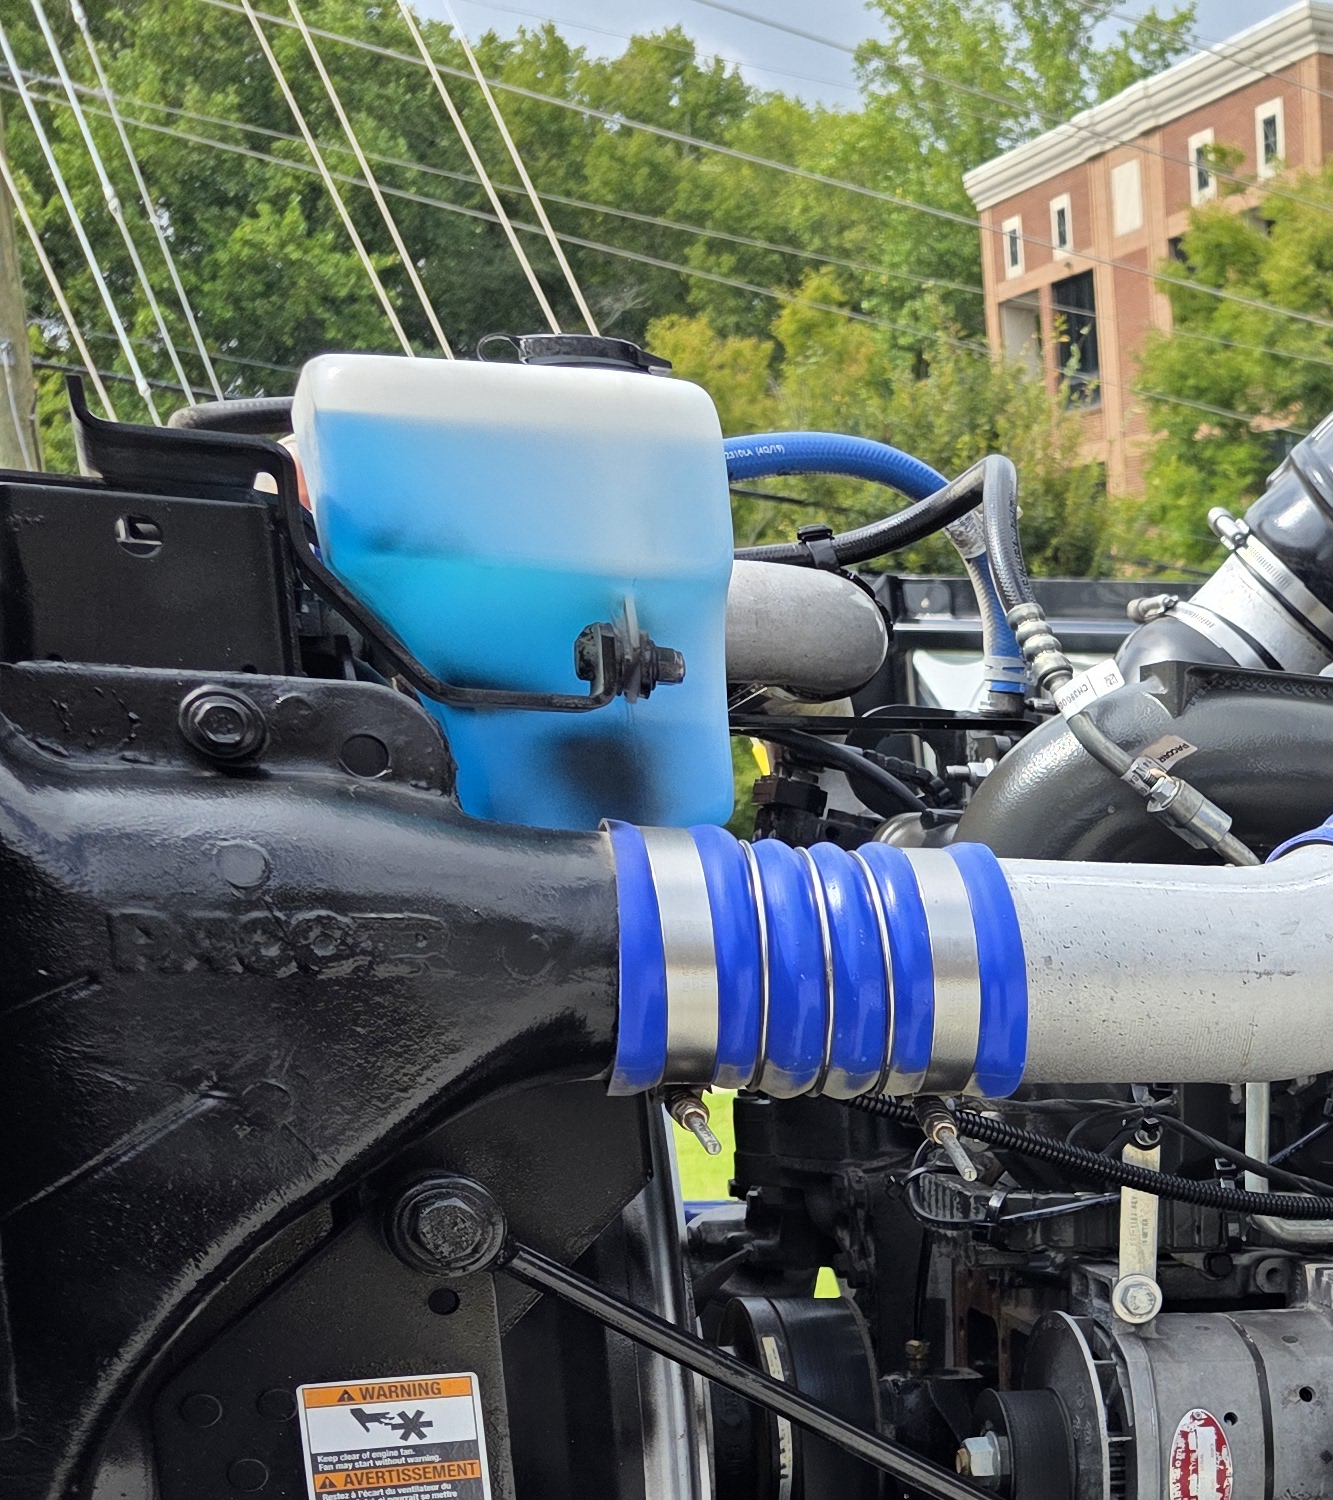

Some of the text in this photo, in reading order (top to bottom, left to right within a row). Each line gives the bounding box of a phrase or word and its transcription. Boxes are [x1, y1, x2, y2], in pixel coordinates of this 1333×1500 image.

[359, 1381, 442, 1401] WARNING
[317, 1448, 416, 1464] Keep clear of engine fan.
[318, 1454, 441, 1471] Fan may start without warning.
[343, 1462, 477, 1487] AVERTISSEMENT
[385, 1487, 396, 1496] du
[397, 1484, 439, 1494] ventilateur
[440, 1483, 451, 1491] du
[420, 1493, 431, 1500] se
[431, 1490, 458, 1499] mettre
